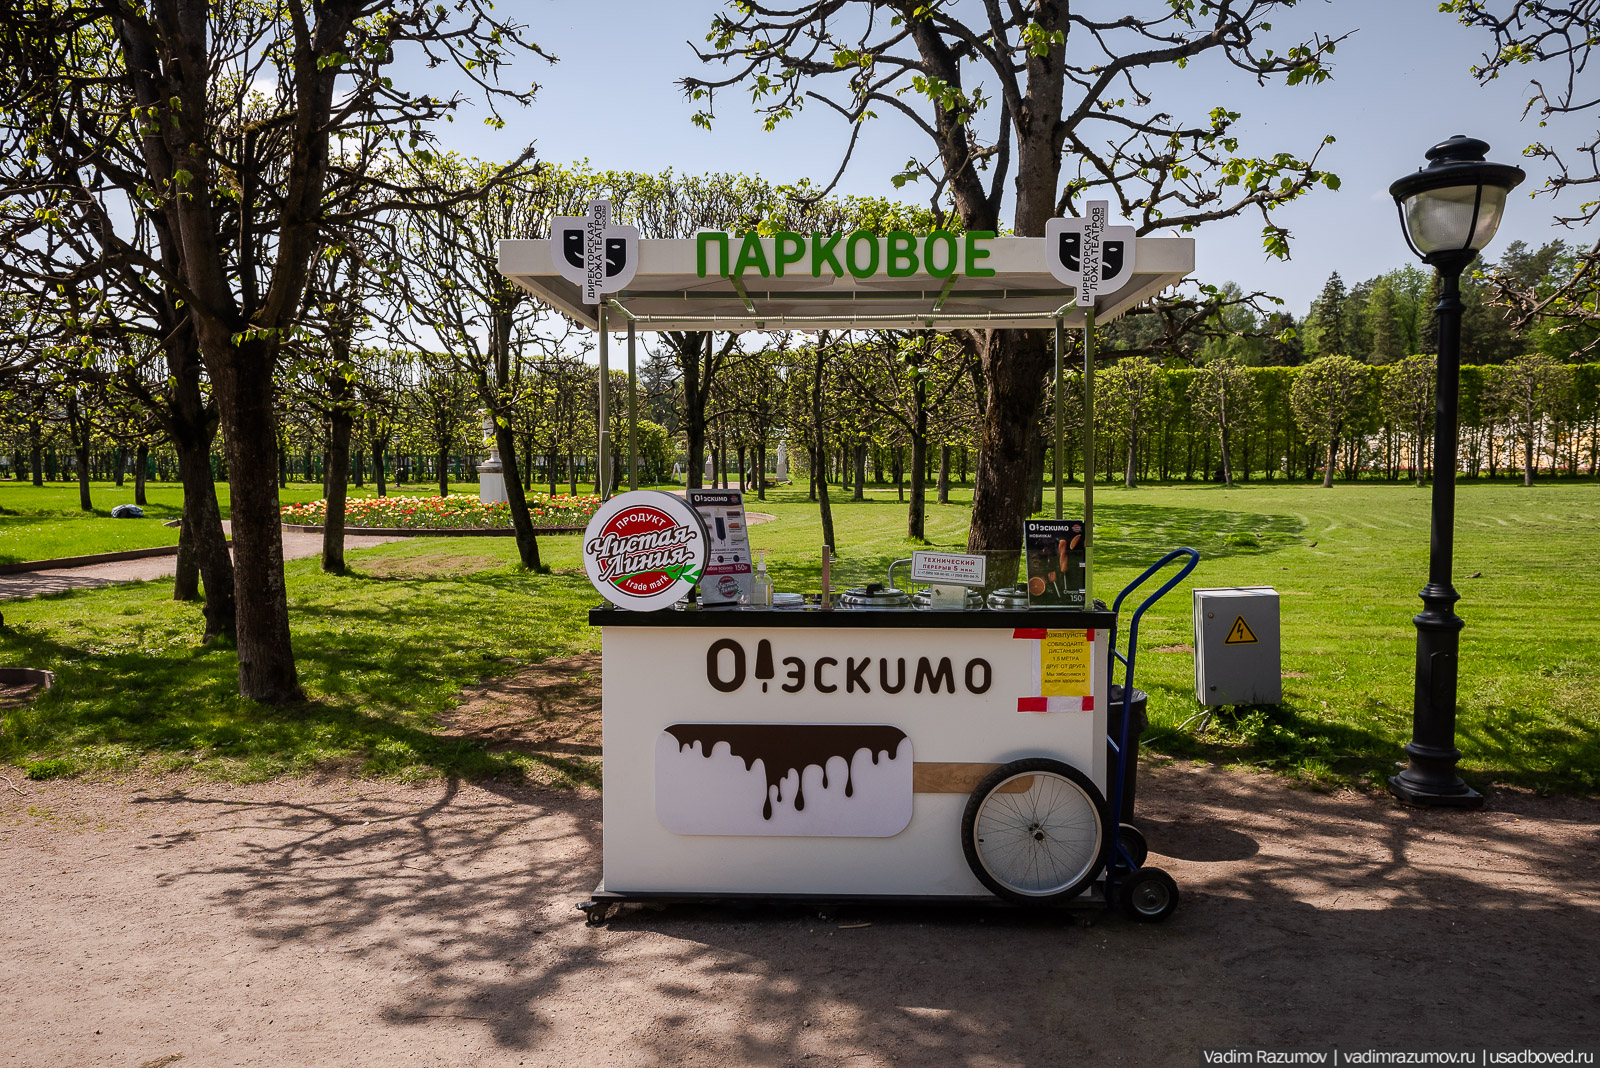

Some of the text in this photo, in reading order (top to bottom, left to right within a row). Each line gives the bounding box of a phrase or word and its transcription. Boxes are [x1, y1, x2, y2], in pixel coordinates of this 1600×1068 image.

[587, 222, 595, 298] ДИРЕКТОРСКАЯ
[594, 204, 603, 287] ЛОЖА ТЕАТРОВ
[697, 230, 996, 279] ПАРКОВОЕ
[1082, 224, 1092, 302] ДИРЕКТОРСКАЯ
[1090, 207, 1100, 291] ЛОЖА ТЕАТРОВ
[616, 513, 667, 529] ПРОДУКТ
[586, 525, 697, 560] Чистая
[598, 546, 695, 581] Линия
[923, 556, 975, 566] ТЕХНИЧЕСКИЙ
[626, 575, 669, 591] trade mark
[1046, 631, 1087, 639] ожалуйста
